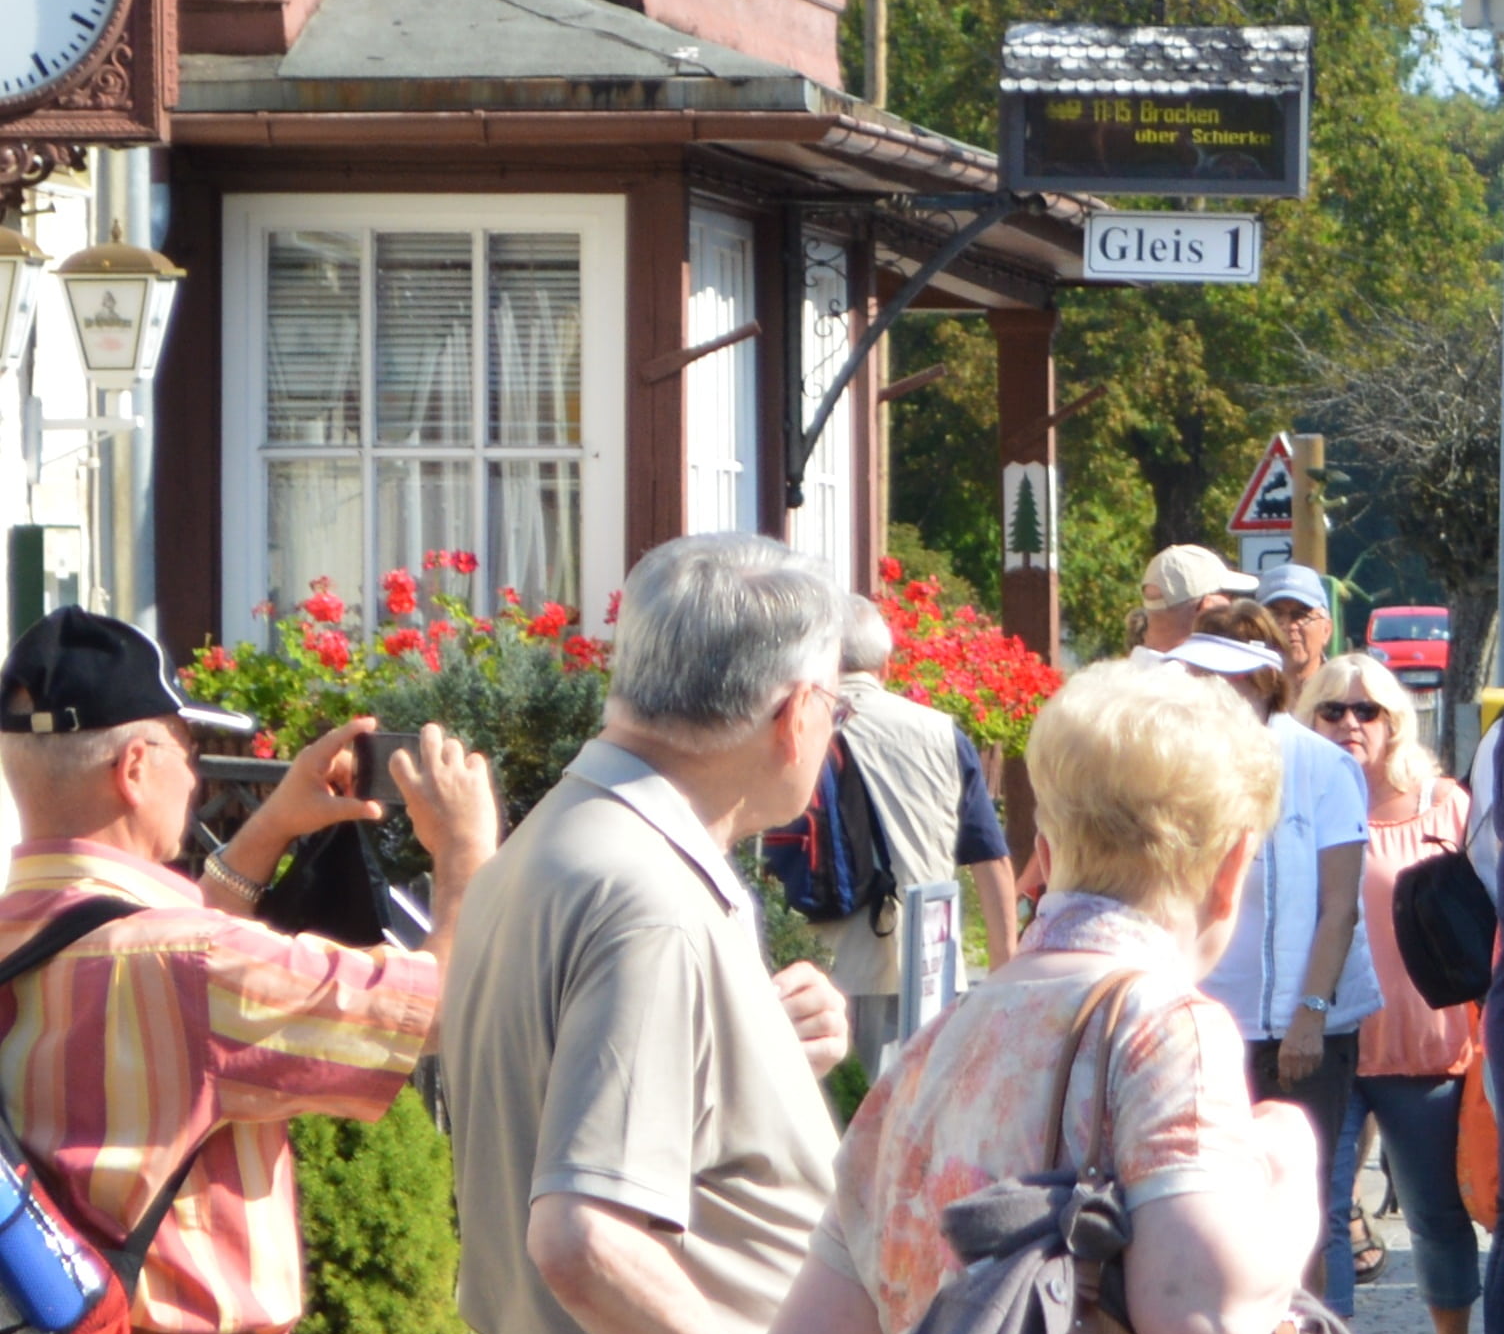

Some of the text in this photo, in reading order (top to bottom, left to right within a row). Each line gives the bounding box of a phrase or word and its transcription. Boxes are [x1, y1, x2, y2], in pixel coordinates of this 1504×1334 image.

[1093, 99, 1220, 123] 11:15 Brocken
[1099, 226, 1244, 269] Gleis 1
